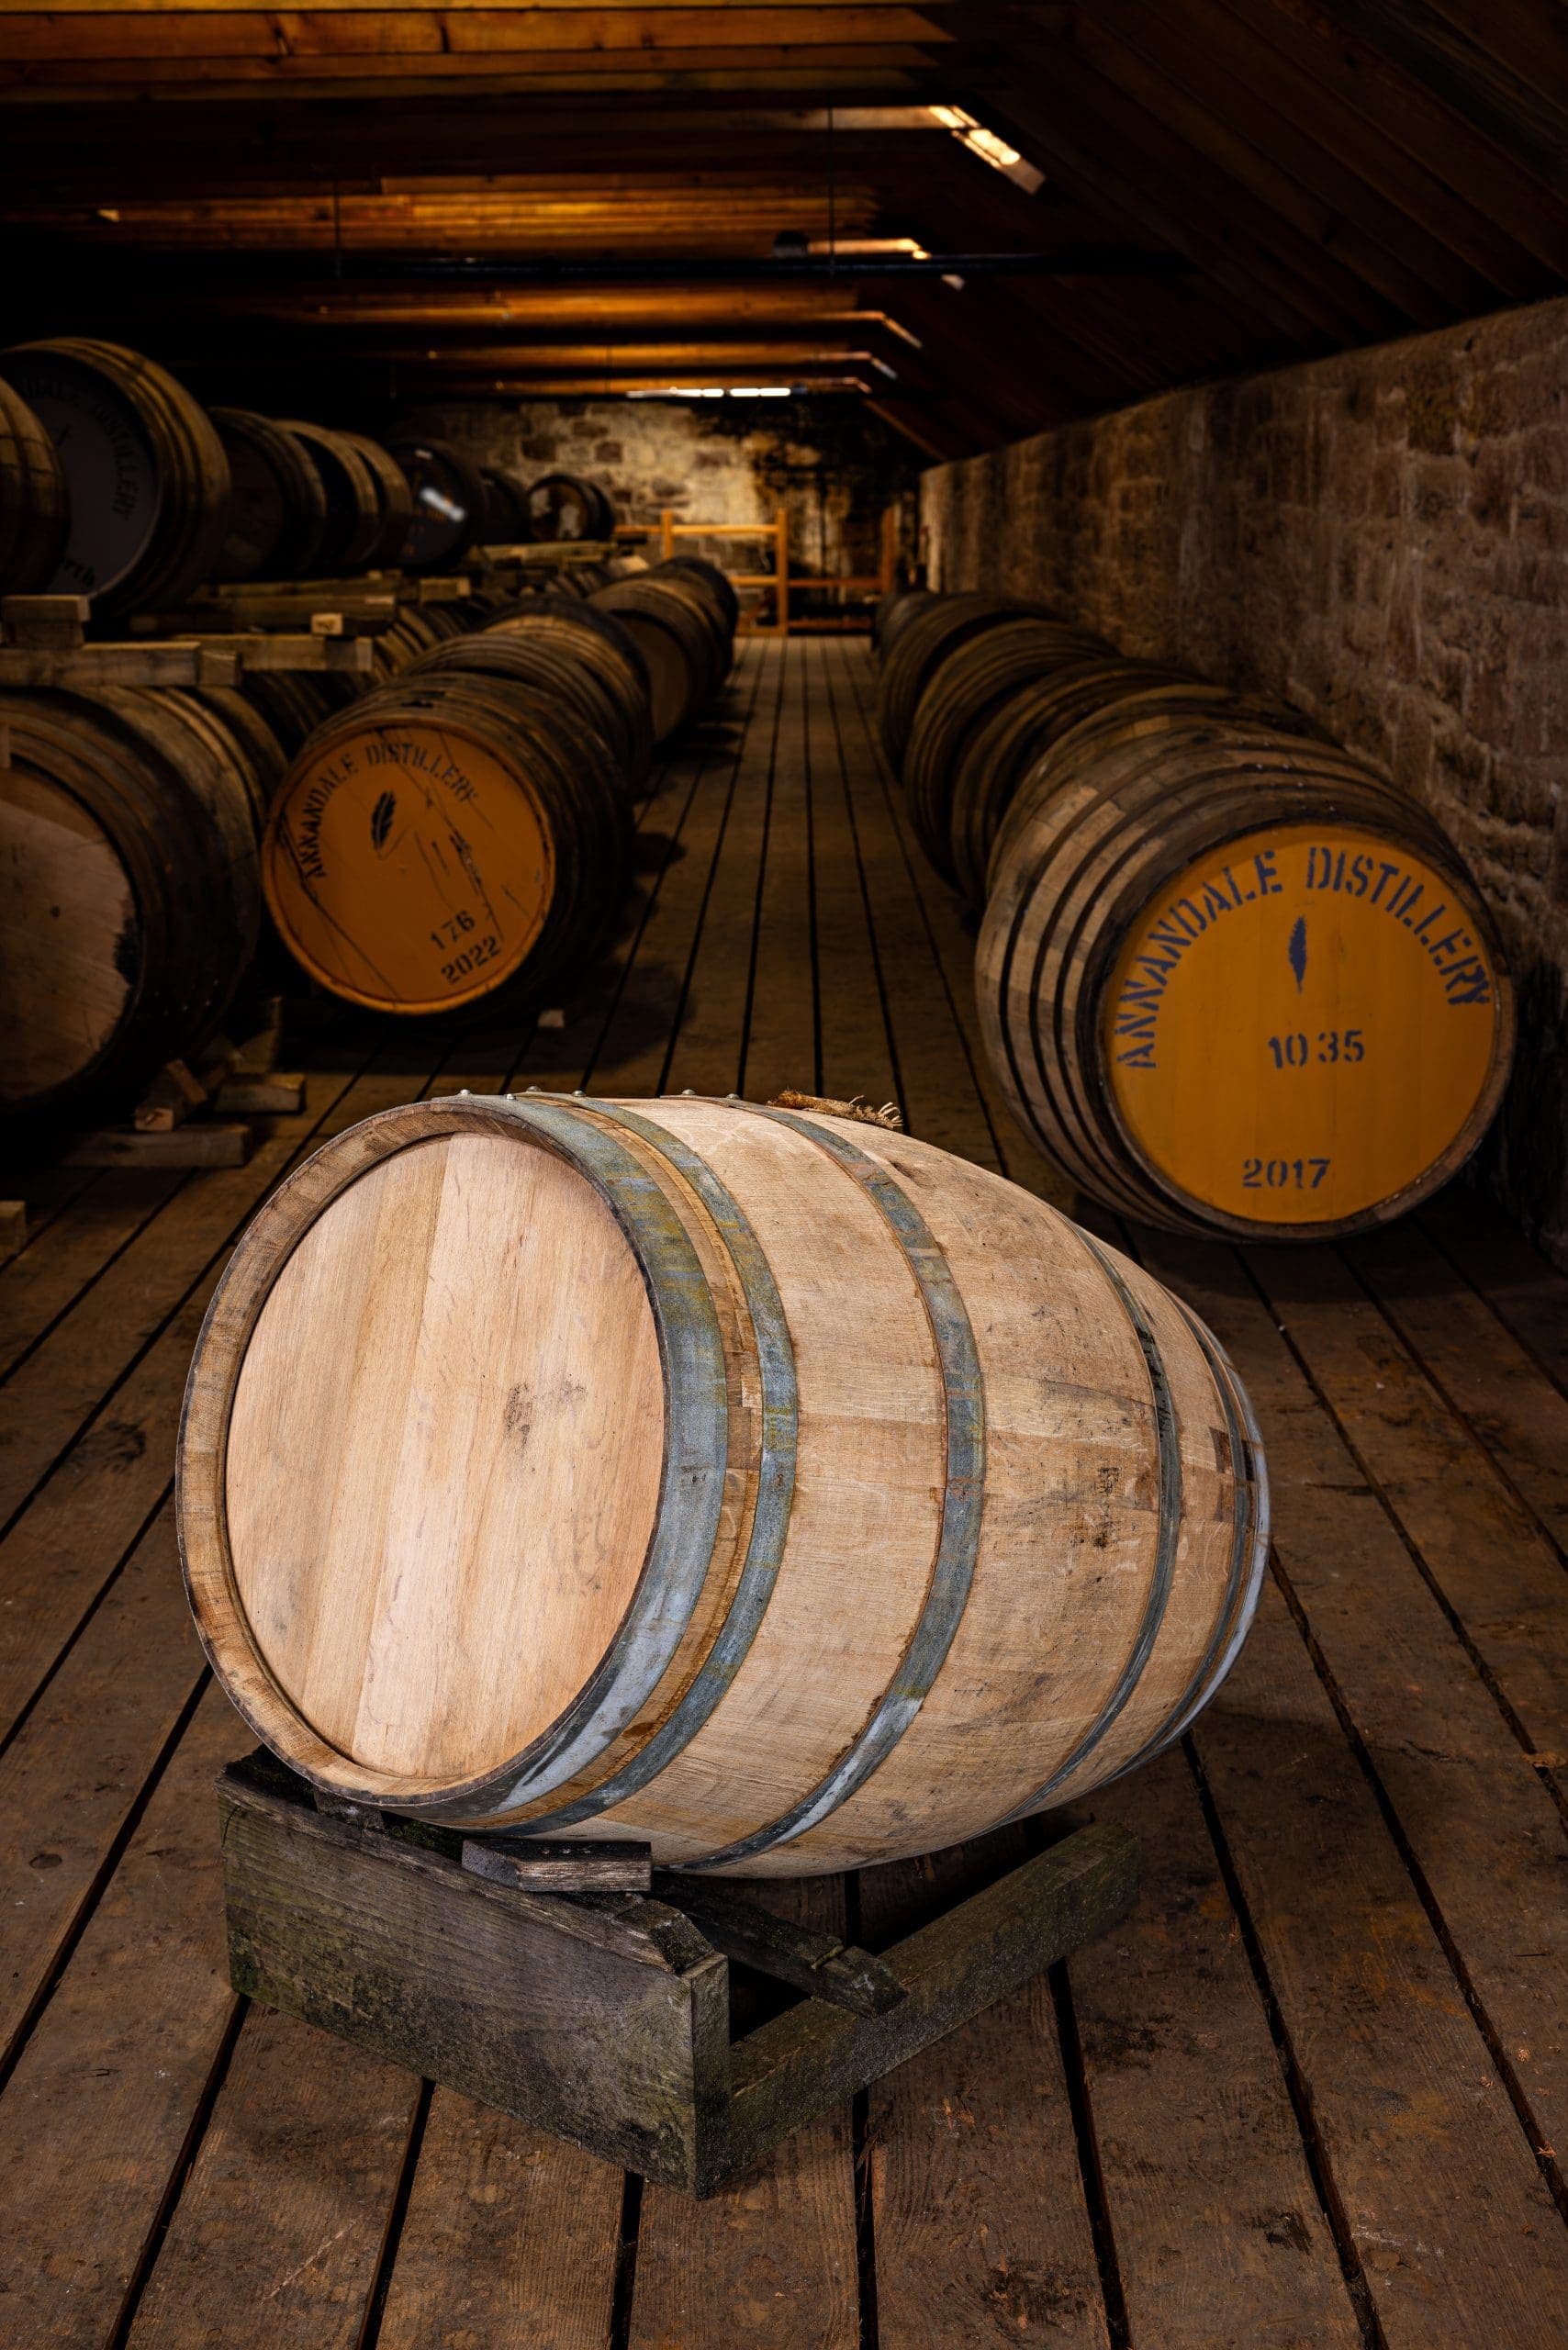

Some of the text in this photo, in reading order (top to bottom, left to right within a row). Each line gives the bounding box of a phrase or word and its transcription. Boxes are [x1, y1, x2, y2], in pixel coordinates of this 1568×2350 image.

[300, 742, 478, 878] ANNANDALE DISTILLERY
[431, 910, 476, 950] 176
[442, 936, 500, 983] 2022
[1114, 846, 1492, 1069] ANNANDALE DISTILLERY
[1268, 1030, 1366, 1069] 1035
[1243, 1158, 1331, 1190] 2017
